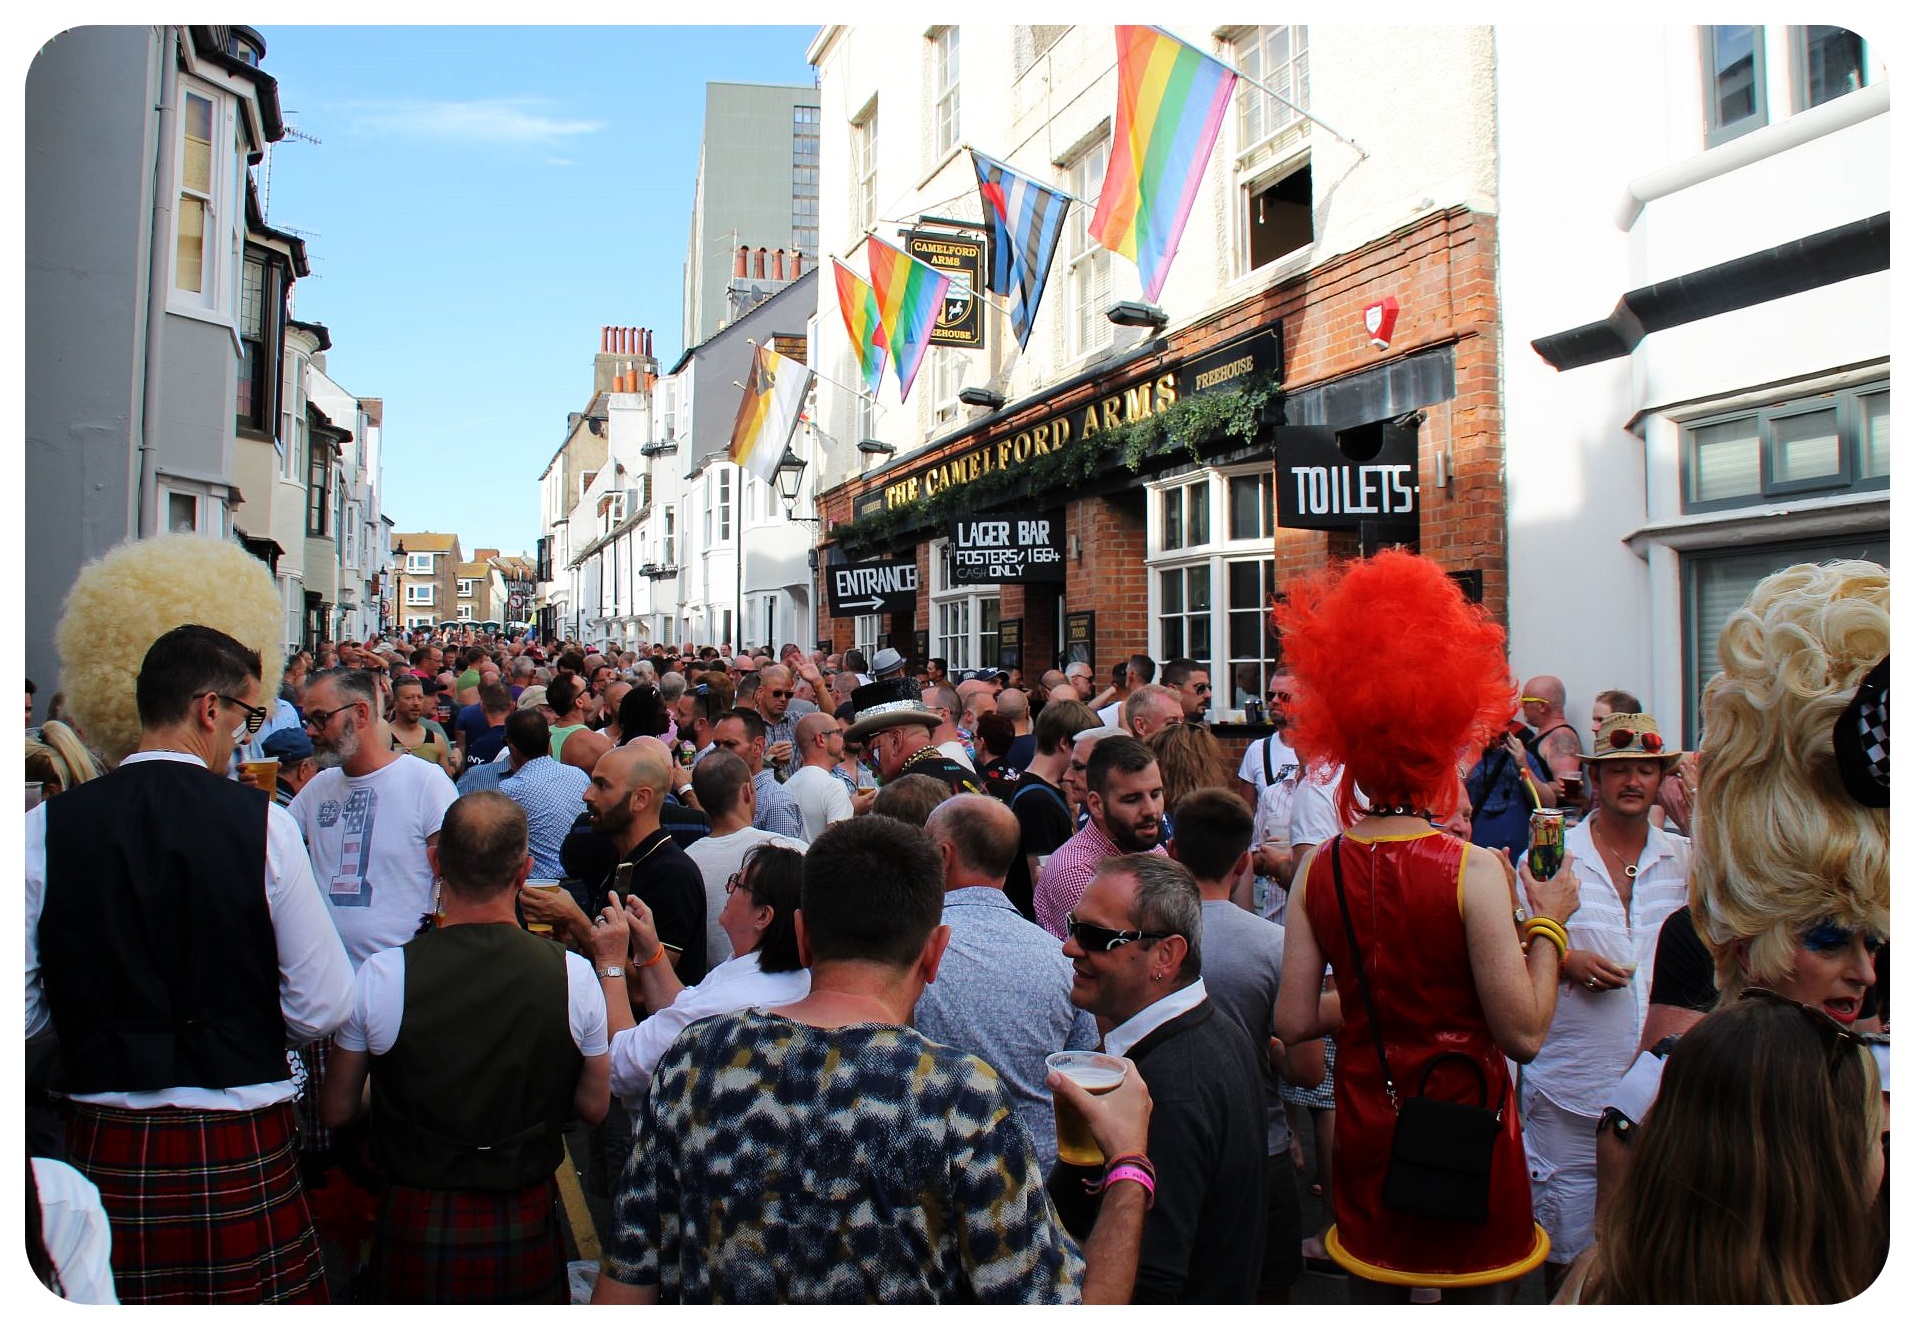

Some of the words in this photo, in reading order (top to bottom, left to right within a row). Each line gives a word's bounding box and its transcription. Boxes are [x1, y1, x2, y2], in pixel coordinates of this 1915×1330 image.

[914, 242, 976, 256] CAMELFORD
[931, 255, 960, 266] ARMS
[931, 328, 971, 339] EEHOUSE
[1195, 355, 1254, 391] FREEHOUSE
[885, 476, 919, 510] THE
[925, 416, 1071, 498] CAMELFORD
[1081, 372, 1178, 440] ARMS
[958, 521, 1010, 547] LAGER
[1017, 520, 1050, 546] BAR
[835, 564, 919, 597] ENTRANCE
[989, 564, 1025, 577] ONLY
